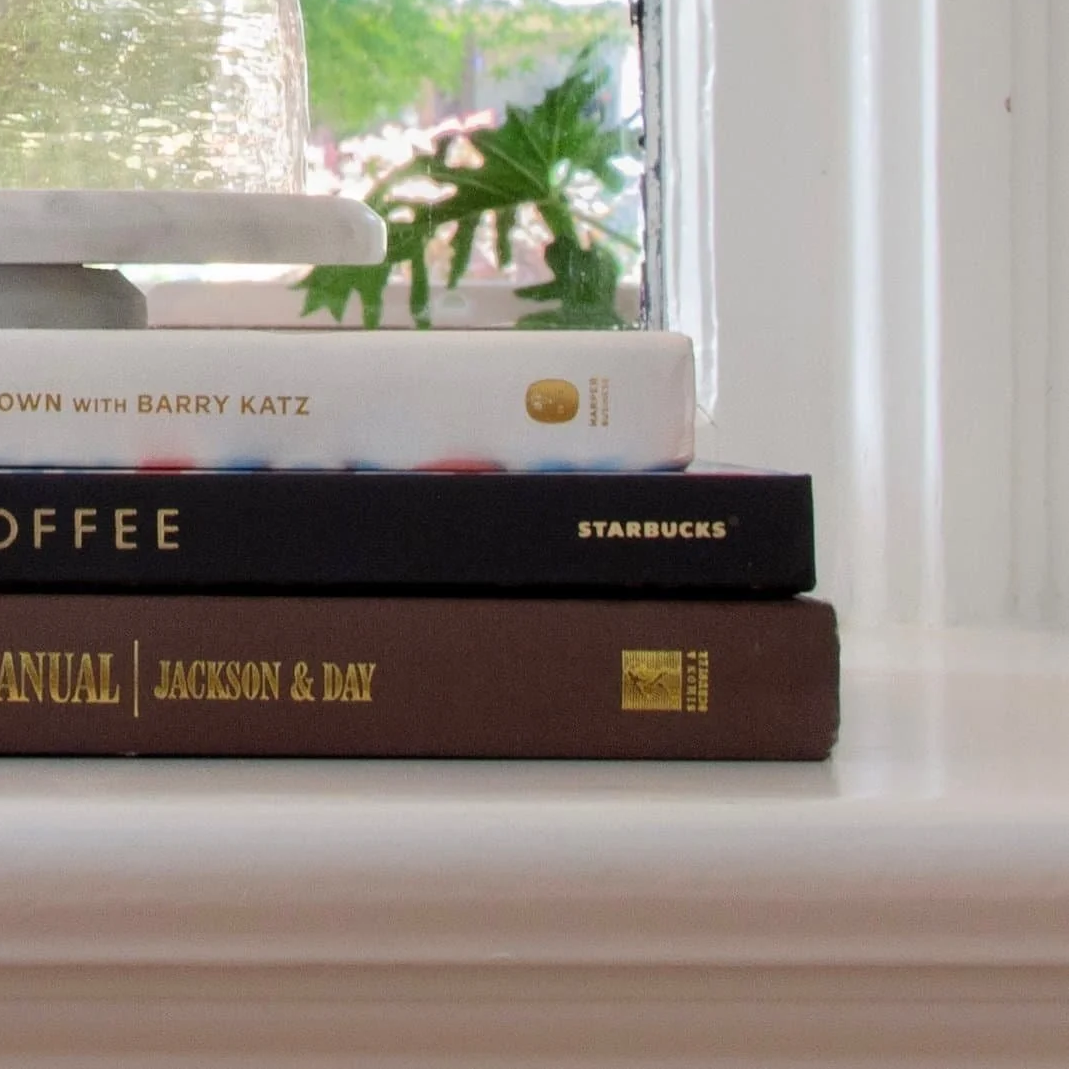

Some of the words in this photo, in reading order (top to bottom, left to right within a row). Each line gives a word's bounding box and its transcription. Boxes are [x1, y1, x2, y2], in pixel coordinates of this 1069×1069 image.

[73, 398, 126, 412] WITH
[138, 395, 229, 414] BARRY
[241, 396, 309, 415] KATZ
[578, 521, 726, 538] STARBUCKS
[154, 660, 281, 700] JACKSON
[291, 661, 315, 701] &
[323, 662, 376, 701] DAY
